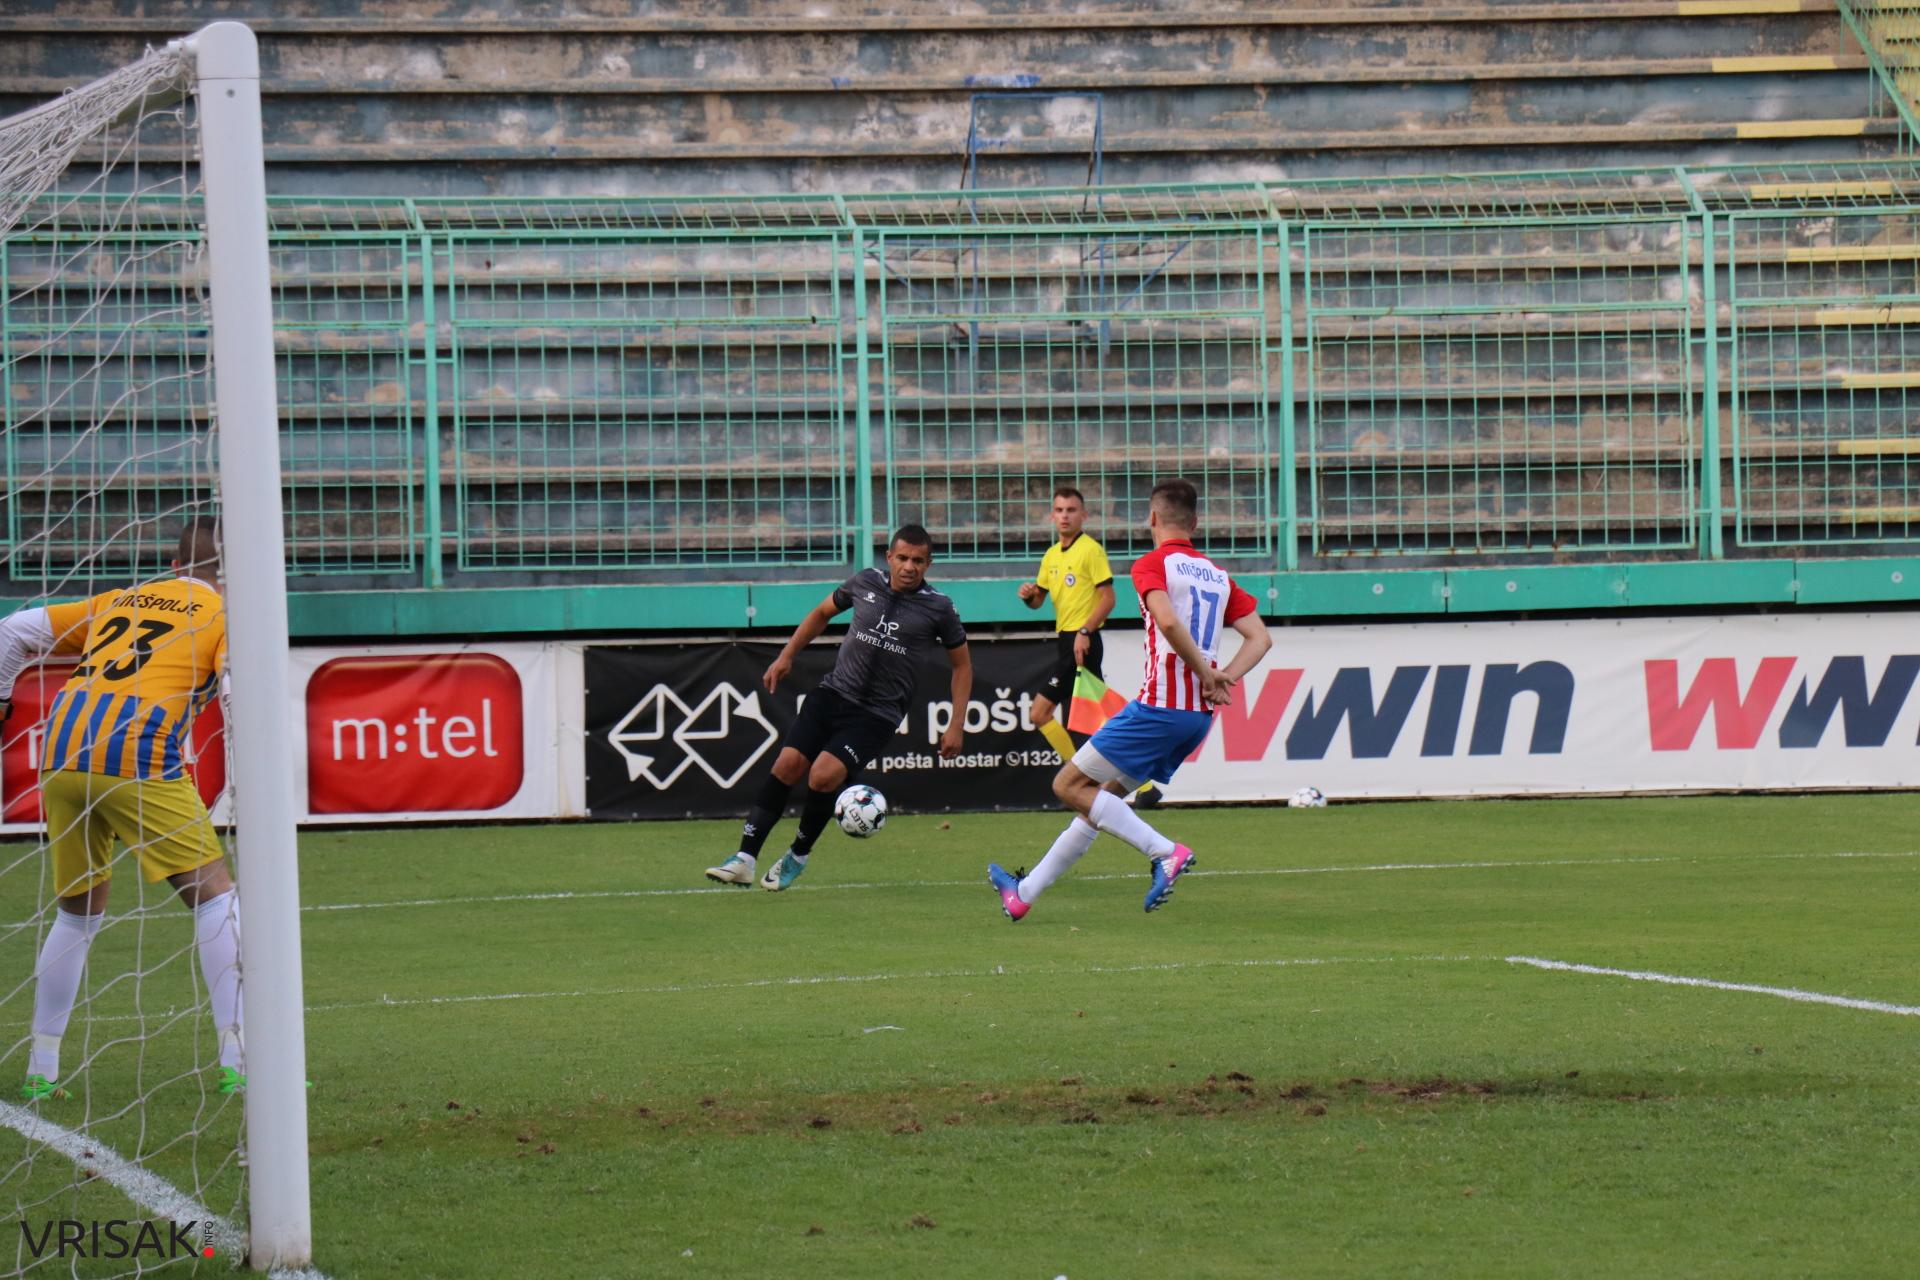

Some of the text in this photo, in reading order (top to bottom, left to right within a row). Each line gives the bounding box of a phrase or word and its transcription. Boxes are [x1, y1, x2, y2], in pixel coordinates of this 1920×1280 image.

[70, 616, 175, 682] 23
[855, 631, 908, 656] HOTEL PARK
[1190, 585, 1220, 651] 17
[332, 698, 499, 760] m:tel
[882, 752, 934, 773] pošta
[937, 750, 1003, 768] Mostar
